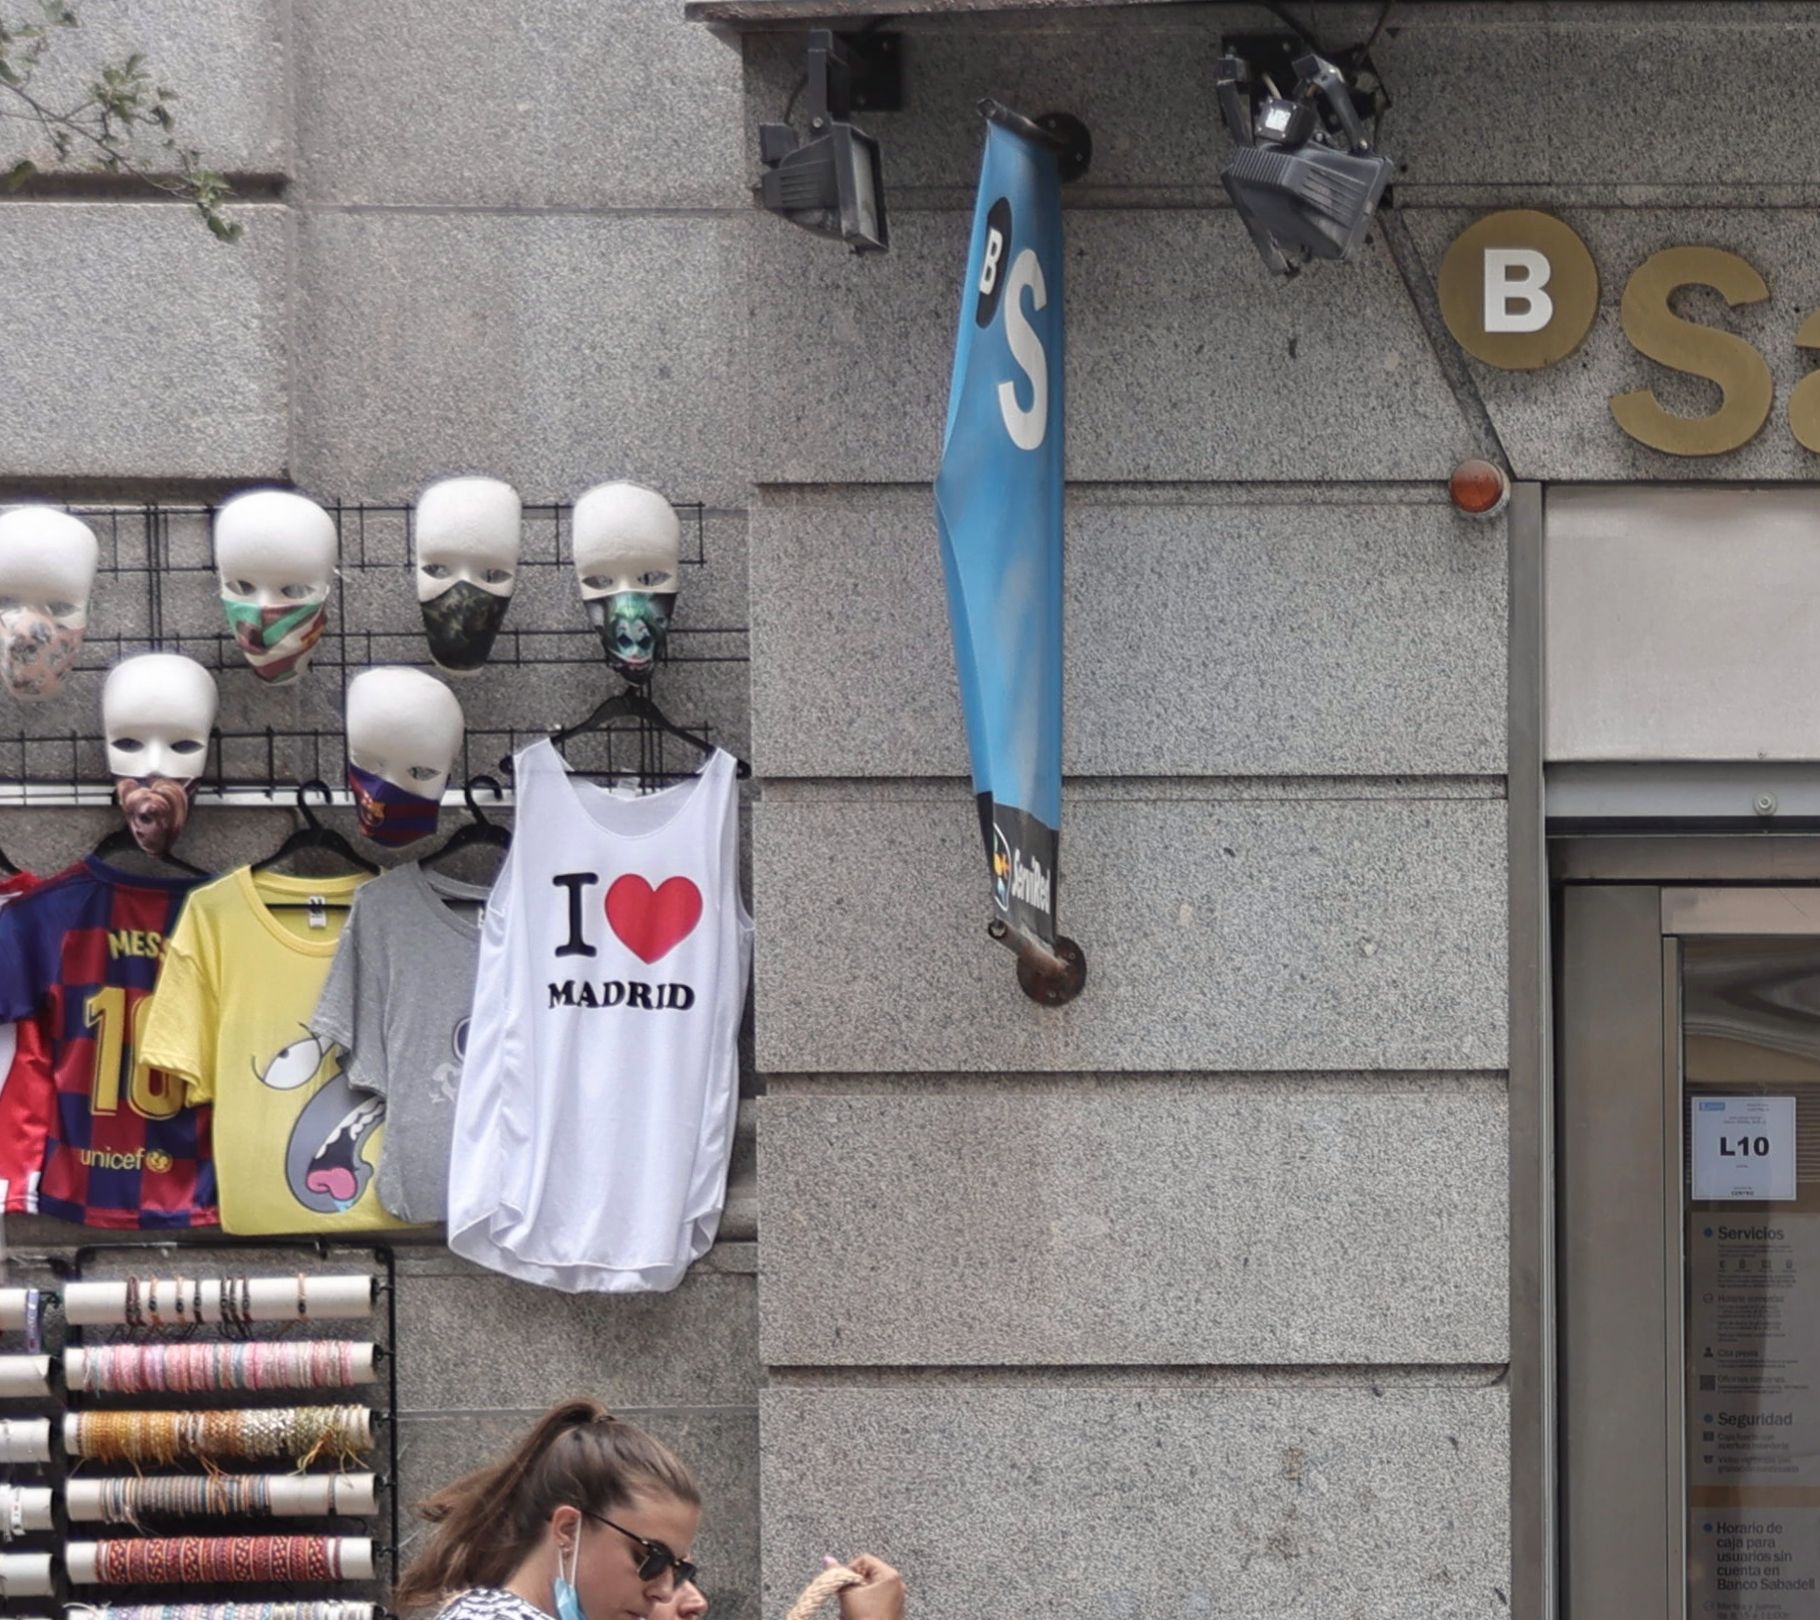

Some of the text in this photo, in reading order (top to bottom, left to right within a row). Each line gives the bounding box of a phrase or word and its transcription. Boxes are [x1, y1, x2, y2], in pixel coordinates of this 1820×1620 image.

[1483, 247, 1554, 333] B
[979, 227, 1048, 450] B S
[552, 872, 599, 958] I
[108, 930, 168, 960] MES
[548, 979, 696, 1011] MADRID
[1720, 1136, 1770, 1156] L10
[80, 1145, 145, 1171] unicef
[1718, 1225, 1785, 1241] Servicios
[1718, 1411, 1792, 1429] Seguridad
[1717, 1521, 1783, 1534] Horario de
[1716, 1537, 1776, 1550] caja para
[1717, 1550, 1792, 1562] usuarios sin
[1716, 1566, 1780, 1576] cuenta en
[1717, 1578, 1815, 1590] Banco Sabadell
